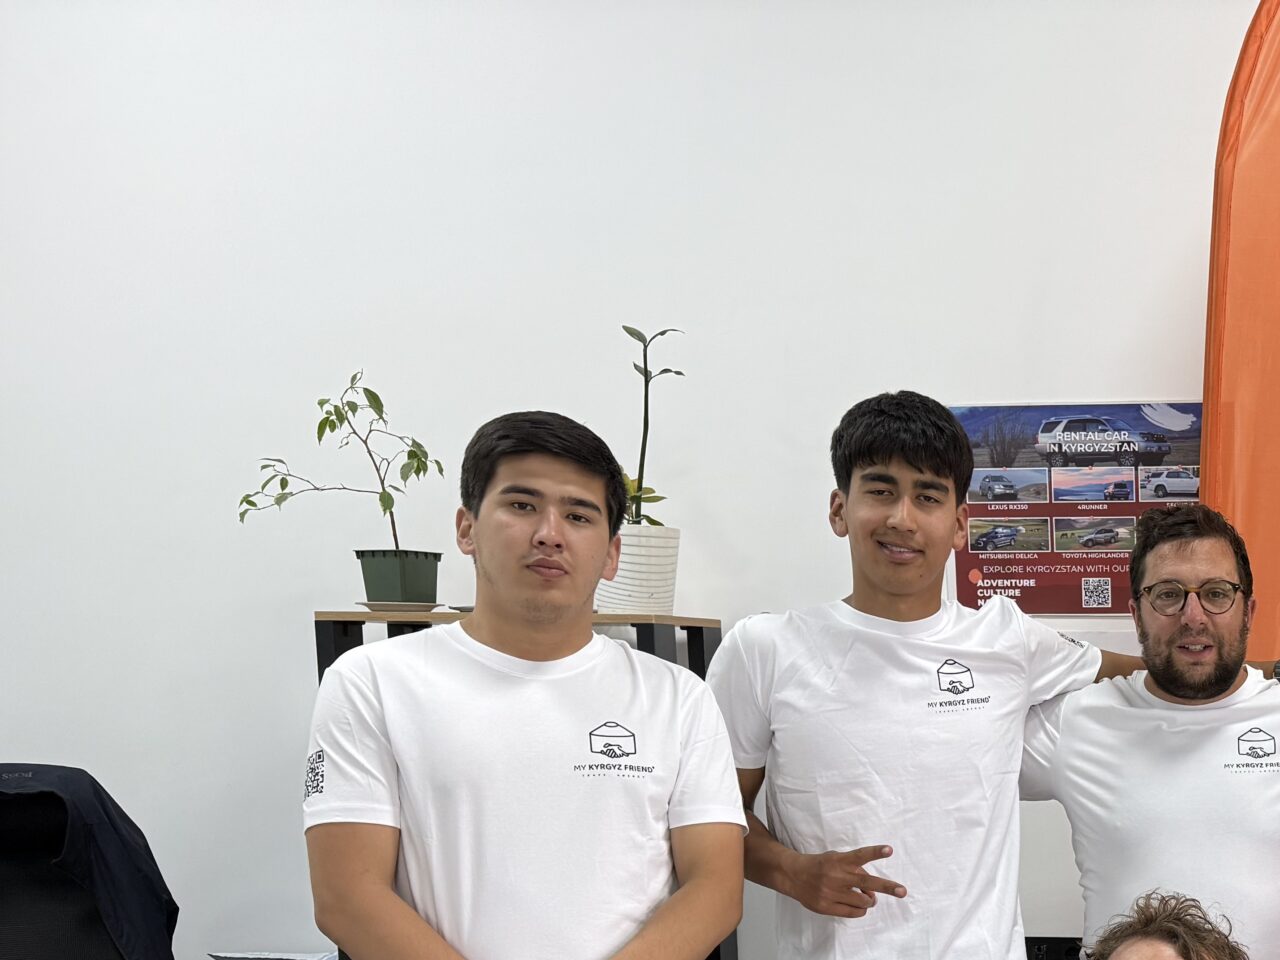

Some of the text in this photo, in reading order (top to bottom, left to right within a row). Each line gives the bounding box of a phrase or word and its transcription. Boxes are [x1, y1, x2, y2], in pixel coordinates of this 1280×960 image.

[1056, 431, 1129, 441] RENTAL CAR
[1046, 442, 1139, 453] IN KYRGYZSTAN
[983, 565, 1024, 573] EXPLORE
[1026, 565, 1084, 573] KYRGYZSTAN
[1086, 565, 1110, 573] WITH
[977, 579, 1036, 587] ADVENTURE
[977, 589, 1021, 597] CULTURE
[939, 699, 965, 707] KYRGYZ
[624, 765, 653, 773] FRIEND
